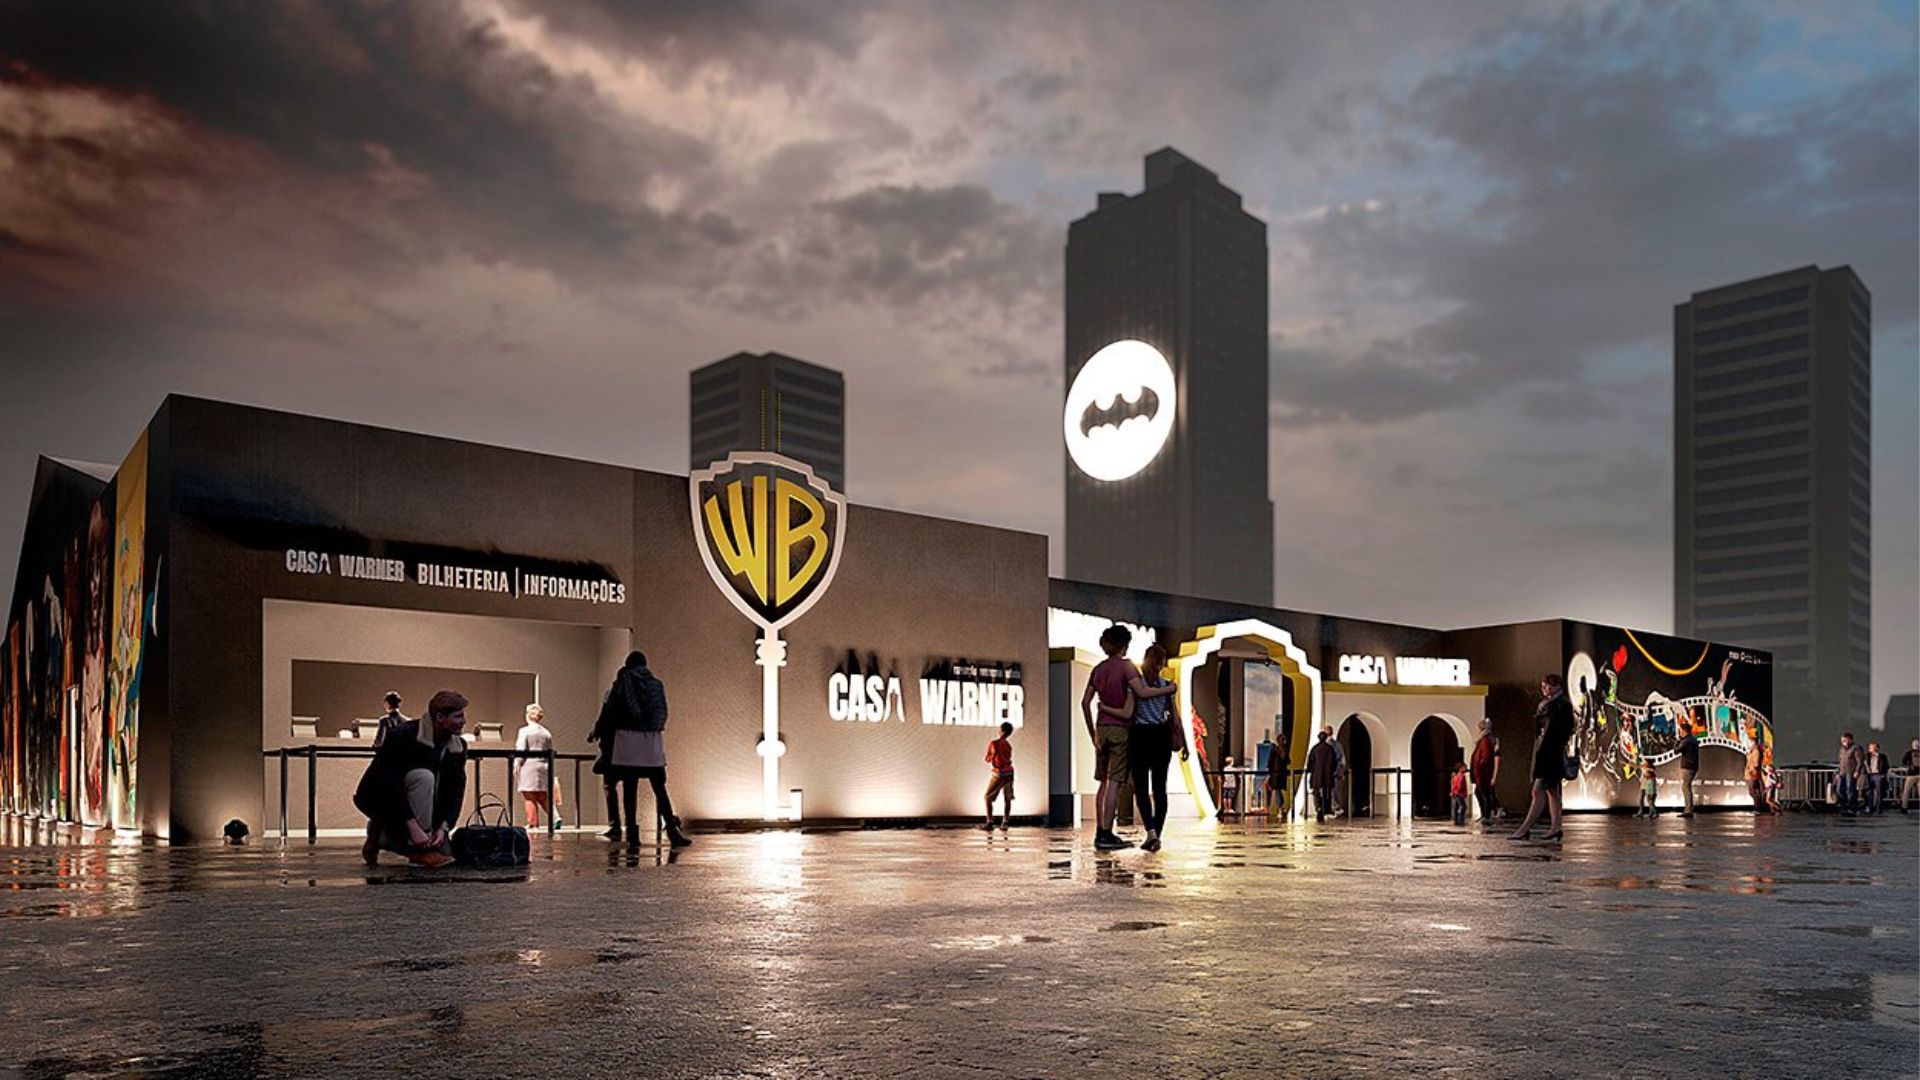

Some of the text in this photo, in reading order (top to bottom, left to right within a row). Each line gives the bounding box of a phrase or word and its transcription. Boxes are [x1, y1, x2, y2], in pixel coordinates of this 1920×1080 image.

[704, 475, 829, 608] WB
[285, 548, 626, 605] CASA WARNER BILHETERIA INFORMAÇÕES
[828, 672, 1025, 728] CASA WARNER
